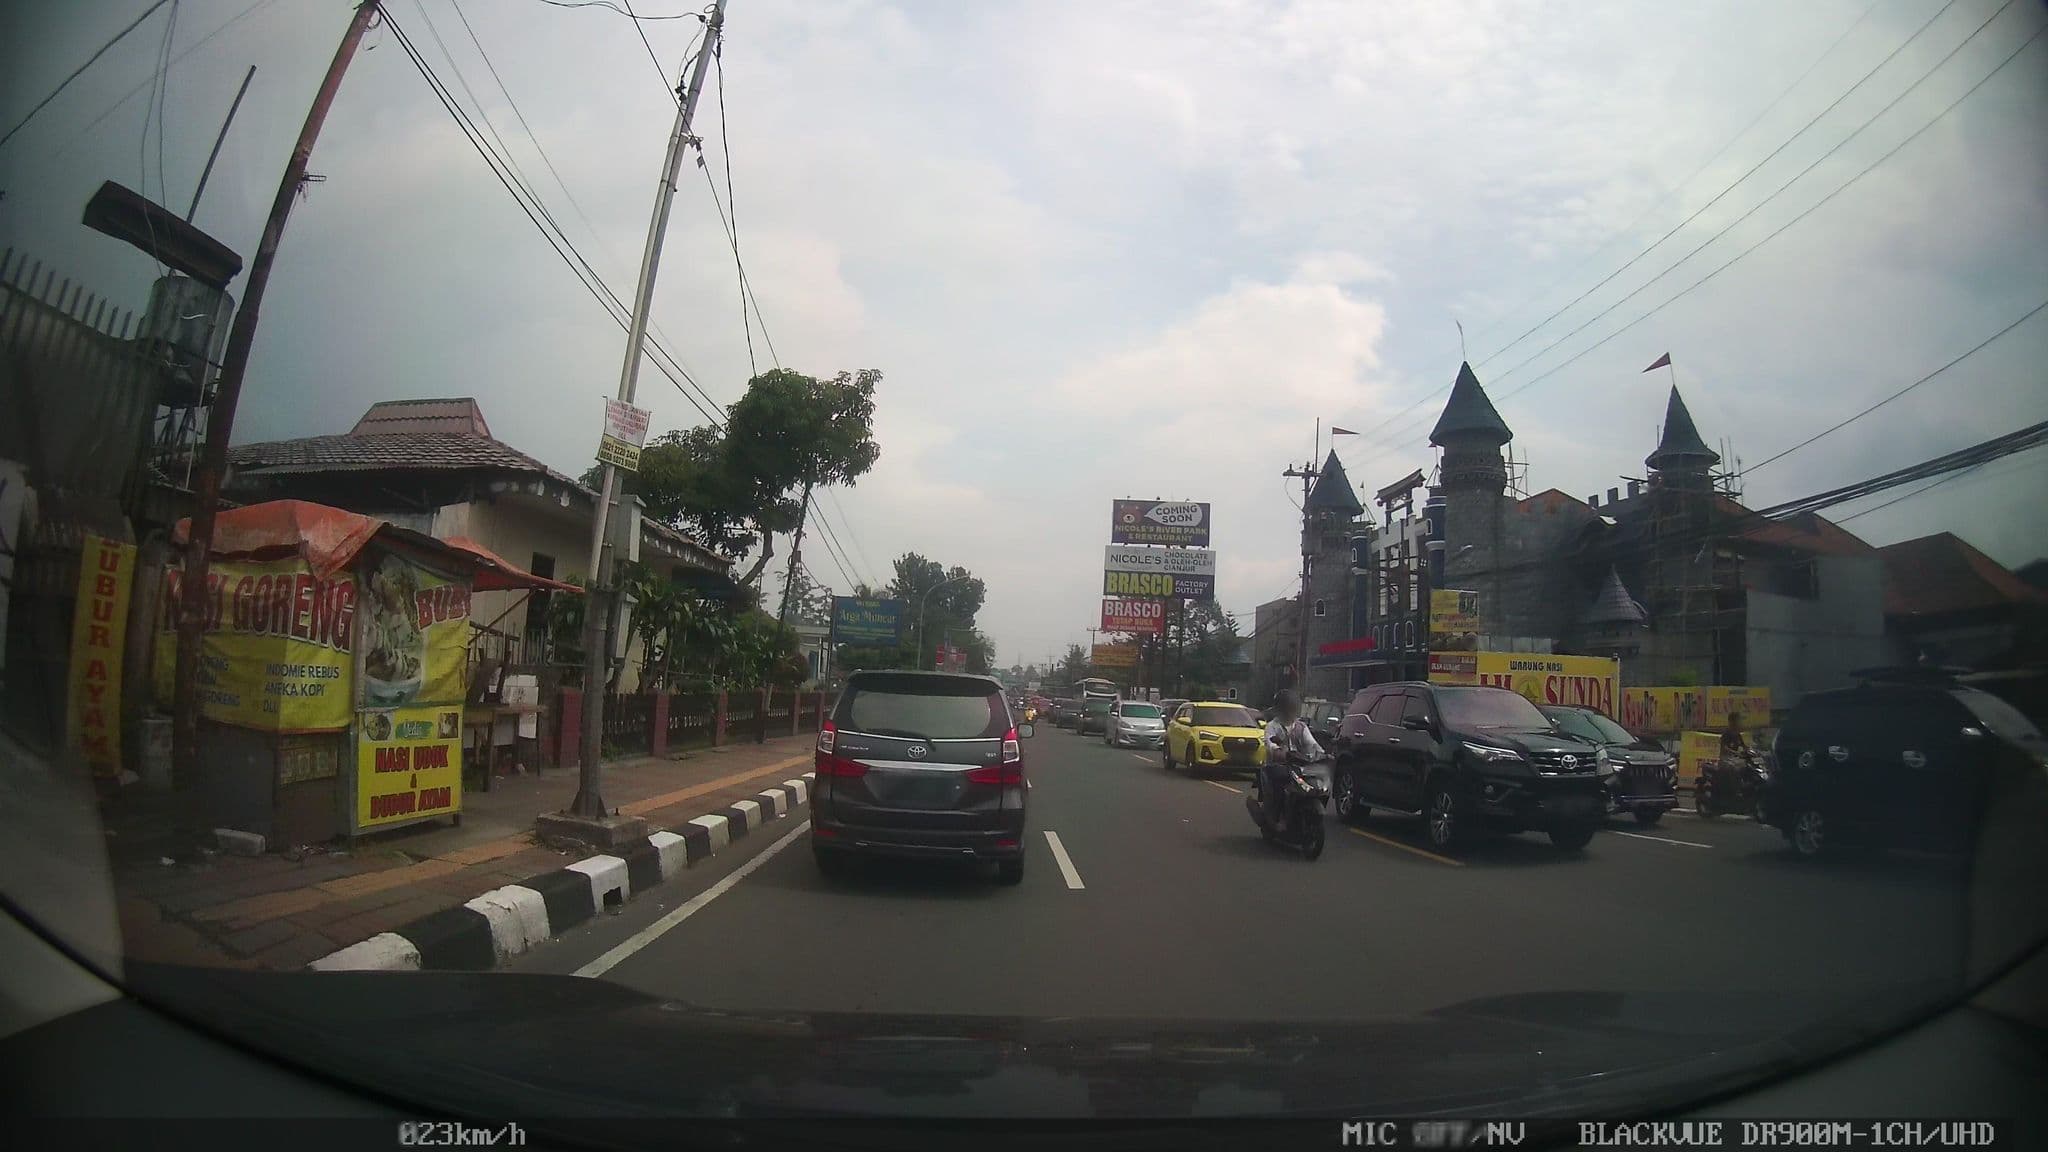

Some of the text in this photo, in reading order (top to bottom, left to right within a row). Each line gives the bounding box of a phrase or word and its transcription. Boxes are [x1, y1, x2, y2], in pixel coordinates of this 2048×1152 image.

[1155, 505, 1198, 516] COMING
[1162, 514, 1193, 524] SOON
[1155, 525, 1182, 534] RIVER
[1184, 527, 1208, 536] PARK
[1134, 532, 1193, 542] RESTAURANT
[1110, 554, 1162, 565] NICOLE'S
[1164, 551, 1209, 560] CHOCOLATE
[1164, 564, 1196, 573] CIANJUR
[1106, 572, 1173, 596] BRASCO
[1175, 580, 1209, 589] FACTORY
[1175, 586, 1204, 595] OUTLET
[232, 572, 353, 655] GORENG
[1104, 601, 1161, 618] BRASCO
[265, 663, 340, 679] INDOMIE REBUS
[1510, 660, 1563, 673] WARUNG NASI
[264, 683, 324, 697] ANEKA KOPI
[1545, 674, 1613, 719] SUNDA
[375, 747, 410, 773] NASI
[417, 787, 451, 814] AYAM
